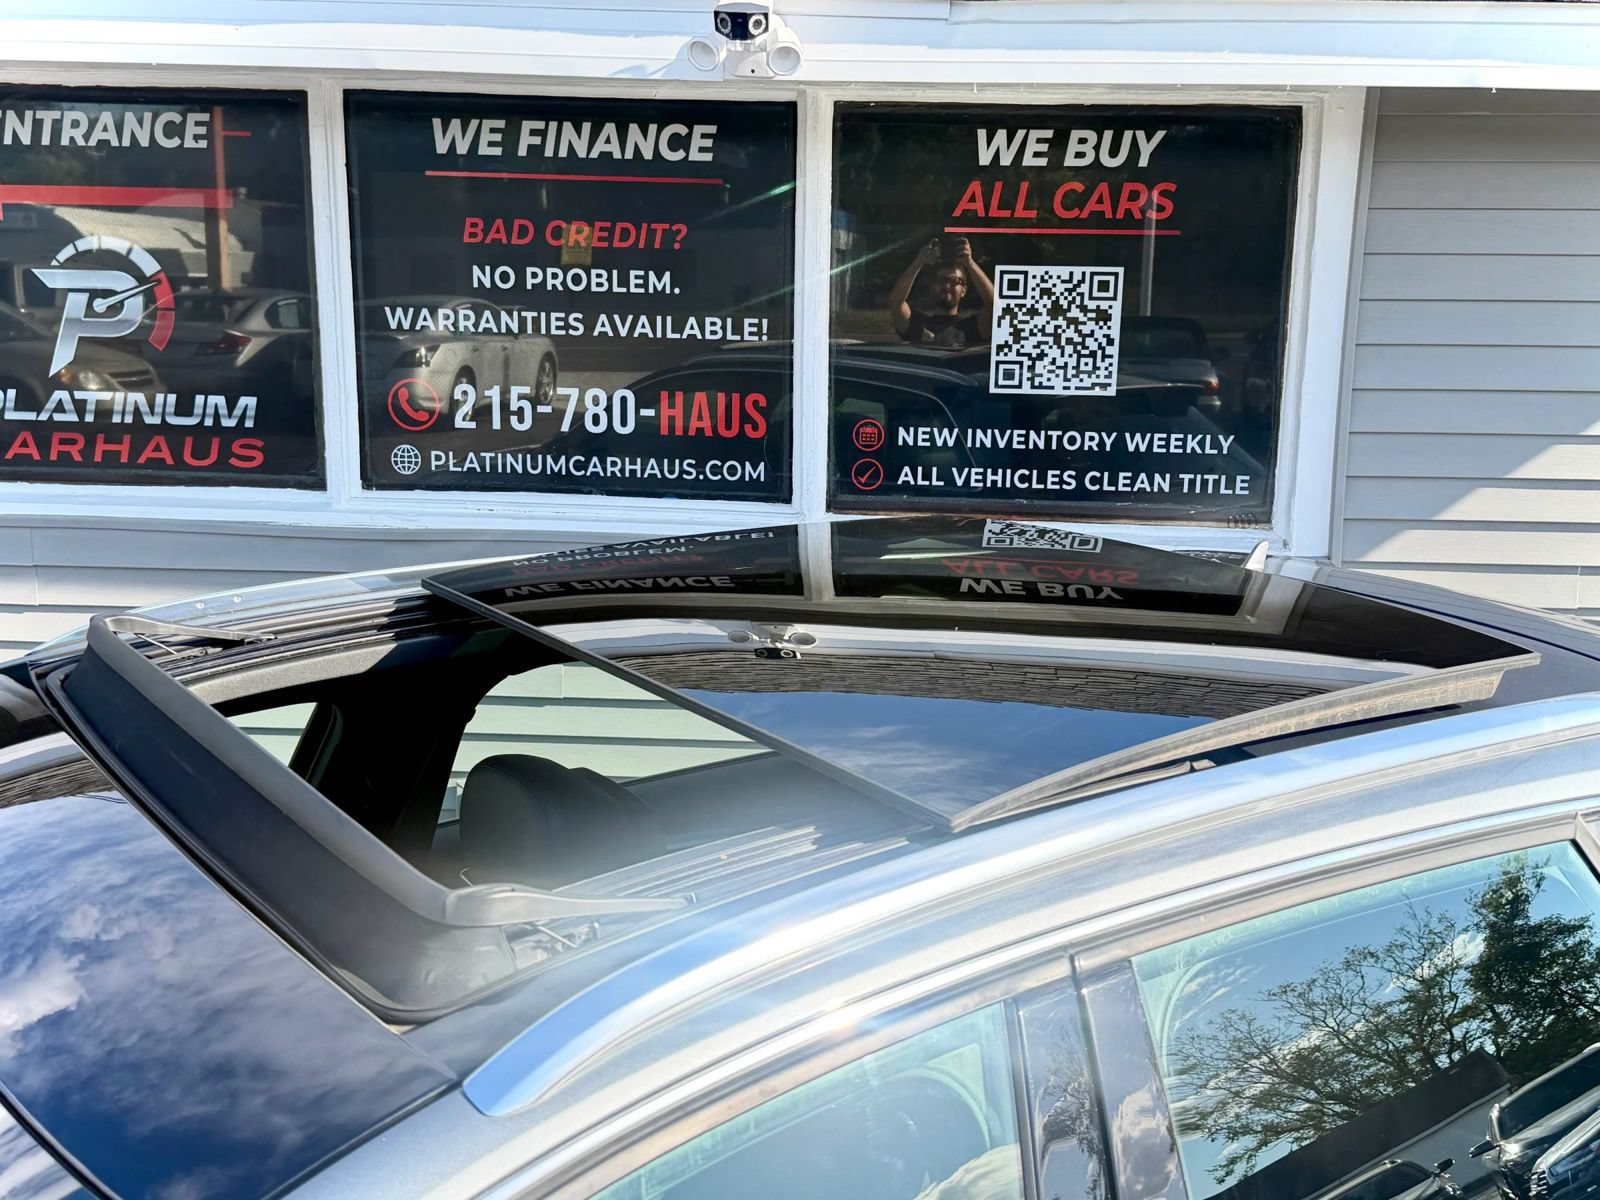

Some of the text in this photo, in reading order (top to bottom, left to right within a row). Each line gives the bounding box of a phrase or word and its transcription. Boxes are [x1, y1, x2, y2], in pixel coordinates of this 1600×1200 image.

[0, 109, 210, 149] NTRANCE
[431, 117, 717, 162] WE FINANCE
[976, 127, 1167, 168] WE BUY
[951, 181, 1178, 220] ALL CARS
[463, 217, 534, 246] BAD
[545, 220, 688, 250] CREDIT?
[472, 264, 681, 295] NO PROBLEM.
[384, 306, 769, 342] WARRANTIES AVAILABLE!
[0, 388, 258, 429] LATINUM
[453, 383, 768, 439] 215-780-HAUS
[4, 430, 267, 469] ARHAUS
[897, 426, 1235, 455] NEW INVENTORY WEEKLY
[430, 450, 766, 482] PLATINUMCARHAUS.COM
[896, 465, 1250, 496] ALL VEHICLES CLEAN TITLE
